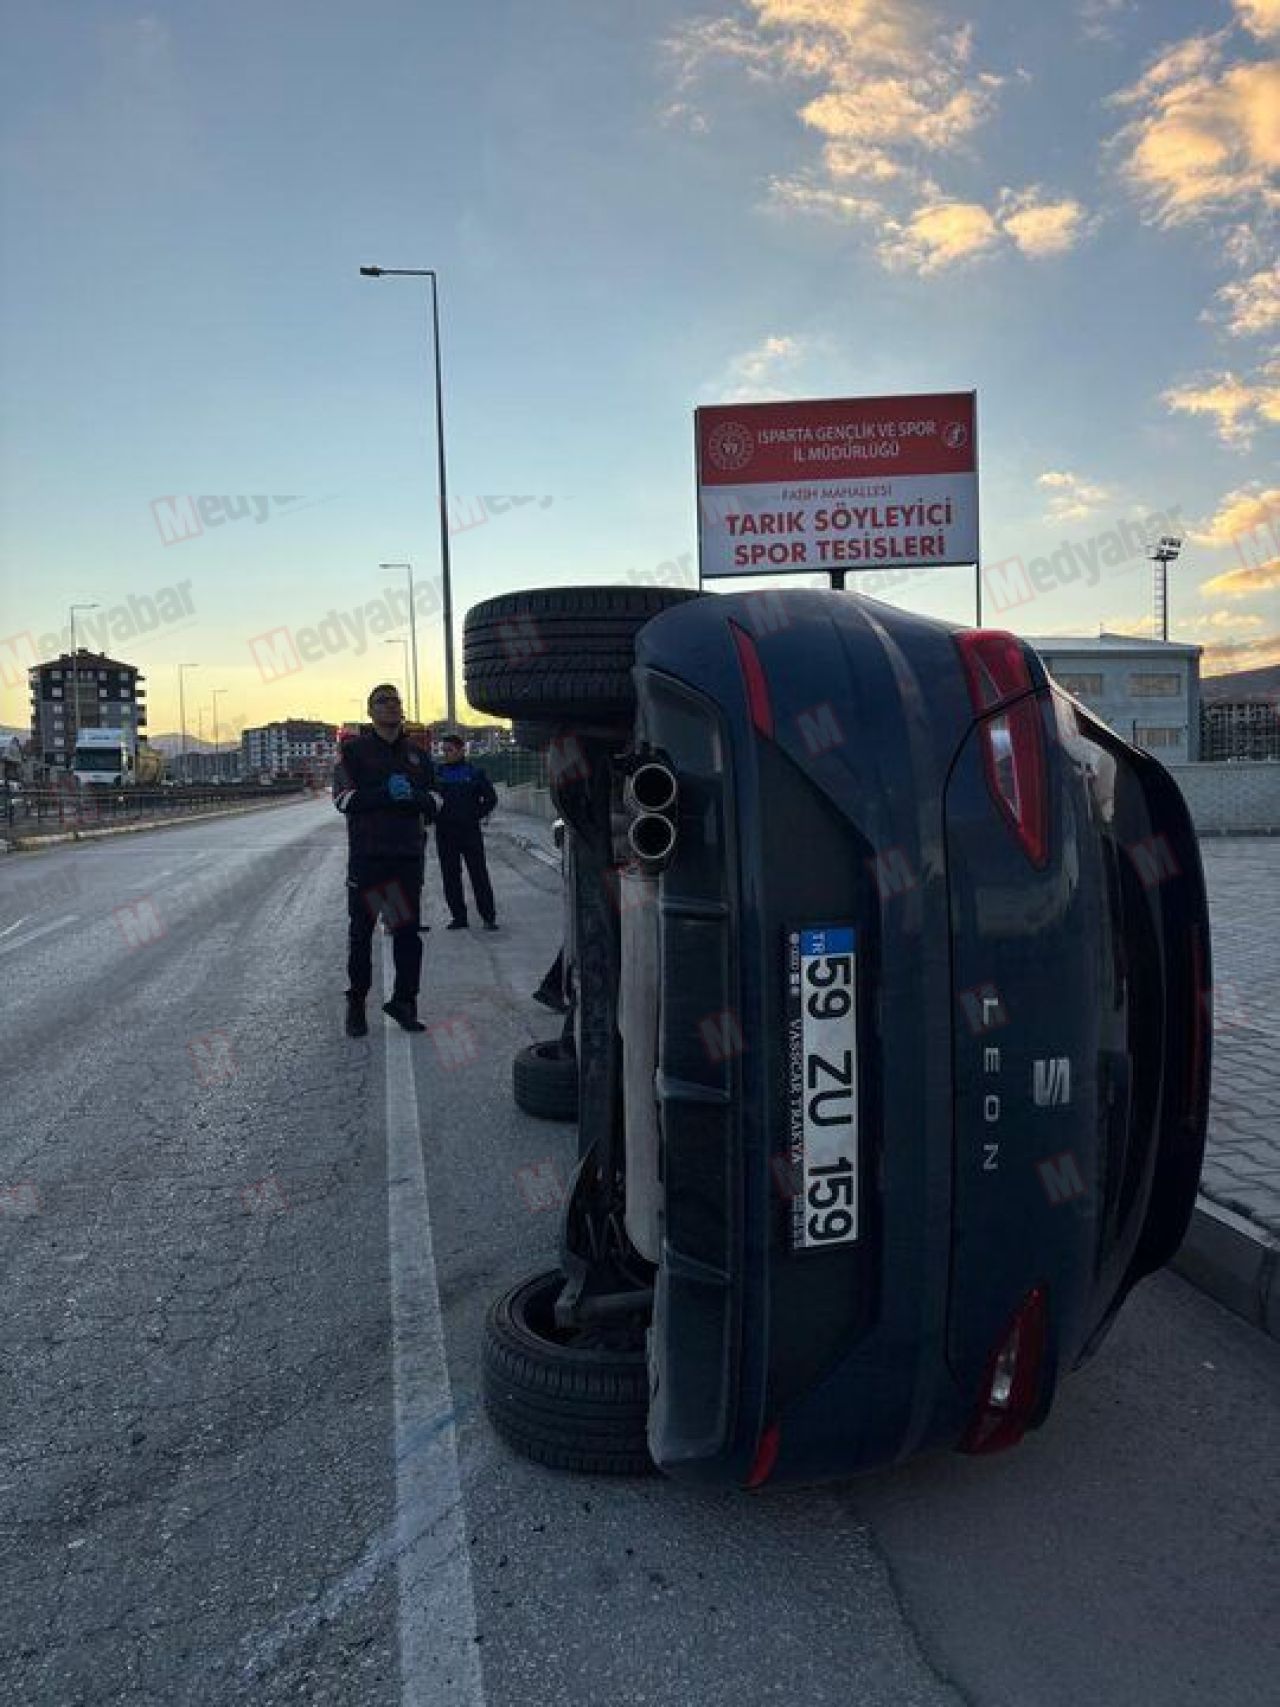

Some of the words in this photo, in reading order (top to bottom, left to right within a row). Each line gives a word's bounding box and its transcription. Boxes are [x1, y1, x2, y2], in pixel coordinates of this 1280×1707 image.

[758, 426, 812, 444] ISPARTA
[876, 422, 896, 438] VE
[898, 420, 937, 437] SPOR
[725, 511, 805, 537] TARIK
[814, 497, 952, 533] SÖYLEYİCİ
[734, 541, 807, 567] SPOR
[815, 529, 945, 562] TESİSLERİ
[812, 933, 826, 954] TR
[806, 957, 851, 1020] 59
[807, 1051, 853, 1127] ZU
[982, 997, 1001, 1170] LEON
[807, 1156, 854, 1241] 159
